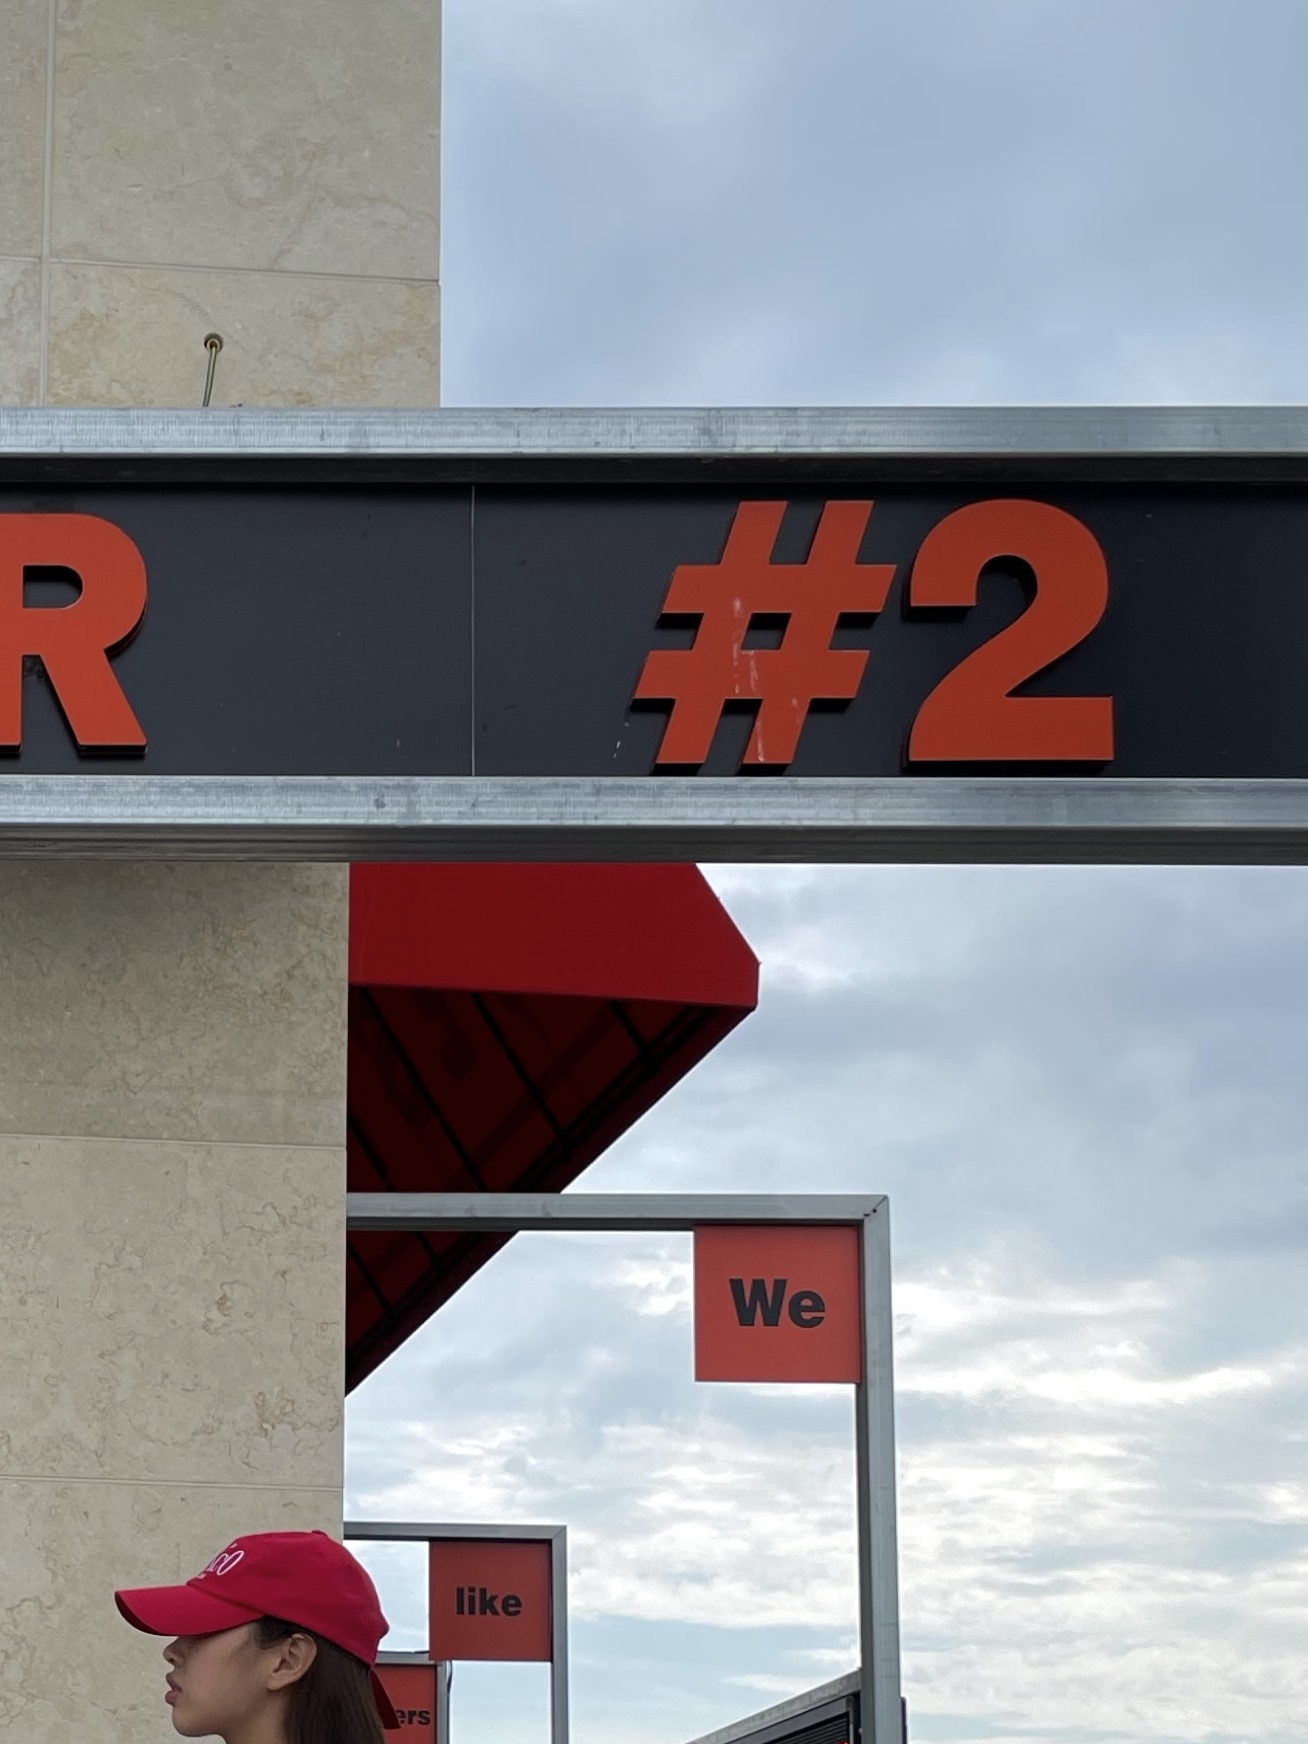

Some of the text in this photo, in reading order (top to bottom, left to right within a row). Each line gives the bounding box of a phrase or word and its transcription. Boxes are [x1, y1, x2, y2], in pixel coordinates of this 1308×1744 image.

[630, 498, 1116, 768] #2
[729, 1278, 826, 1329] We
[455, 1586, 523, 1617] like
